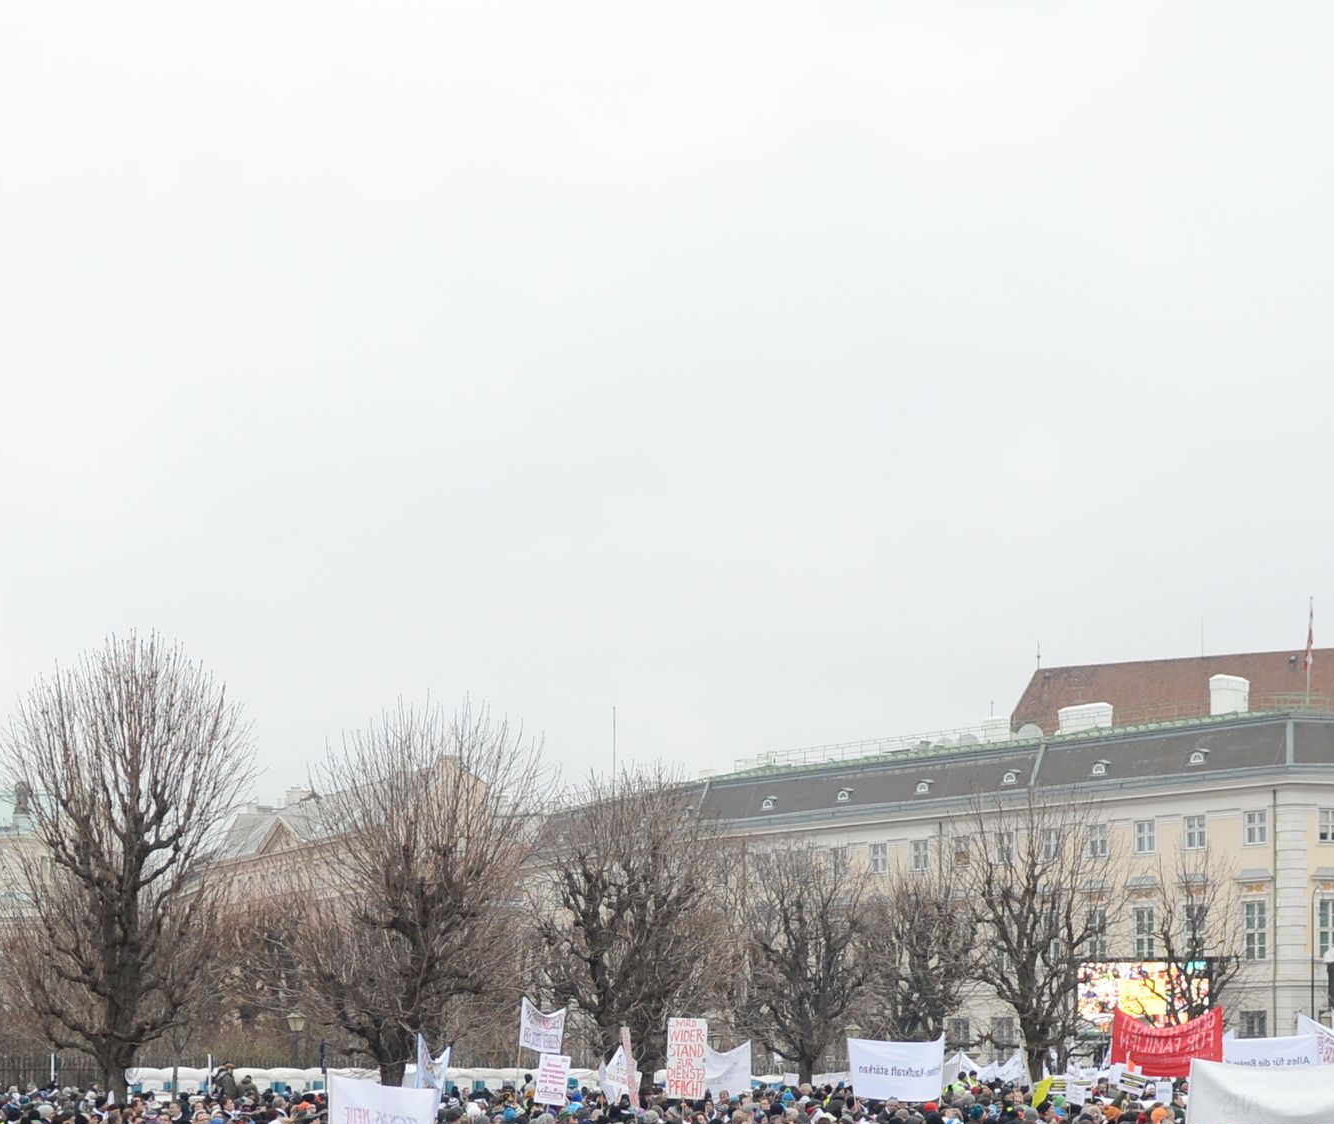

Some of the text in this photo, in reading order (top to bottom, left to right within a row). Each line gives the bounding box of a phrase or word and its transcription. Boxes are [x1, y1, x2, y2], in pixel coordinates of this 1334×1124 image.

[669, 1029, 705, 1042] WIDER-
[669, 1043, 704, 1057] STAND
[669, 1079, 705, 1097] PFLICHT
